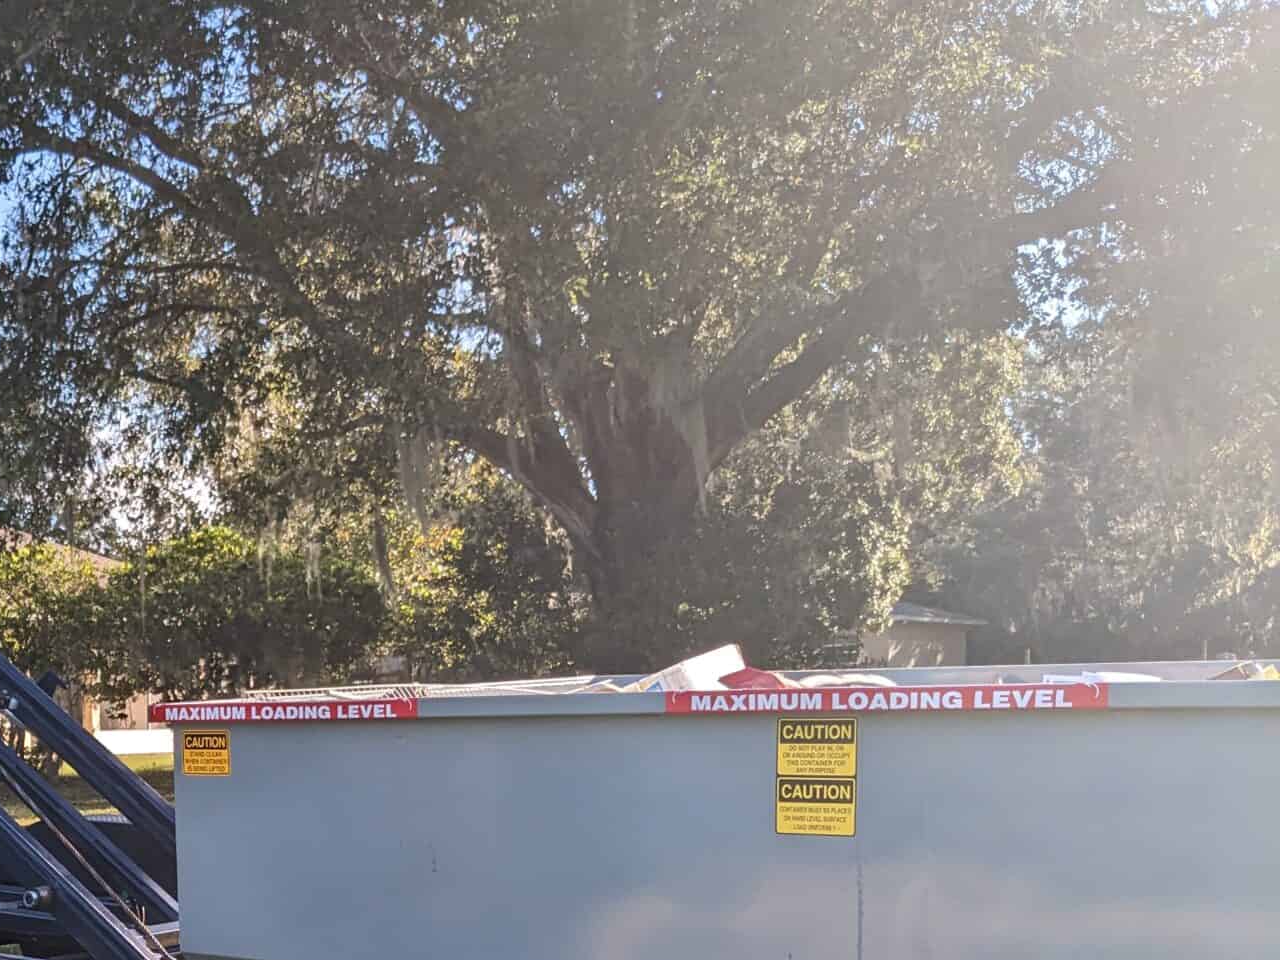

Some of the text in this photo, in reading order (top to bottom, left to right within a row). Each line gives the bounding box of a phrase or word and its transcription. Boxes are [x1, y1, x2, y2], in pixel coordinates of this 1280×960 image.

[690, 688, 1073, 711] MAXIMUM LOADING LEVEL
[165, 703, 397, 721] MAXIMUM LOADING LEVEL
[782, 724, 852, 740] CAUTION
[185, 736, 226, 749] CAUTION
[781, 784, 851, 799] CAUTION
